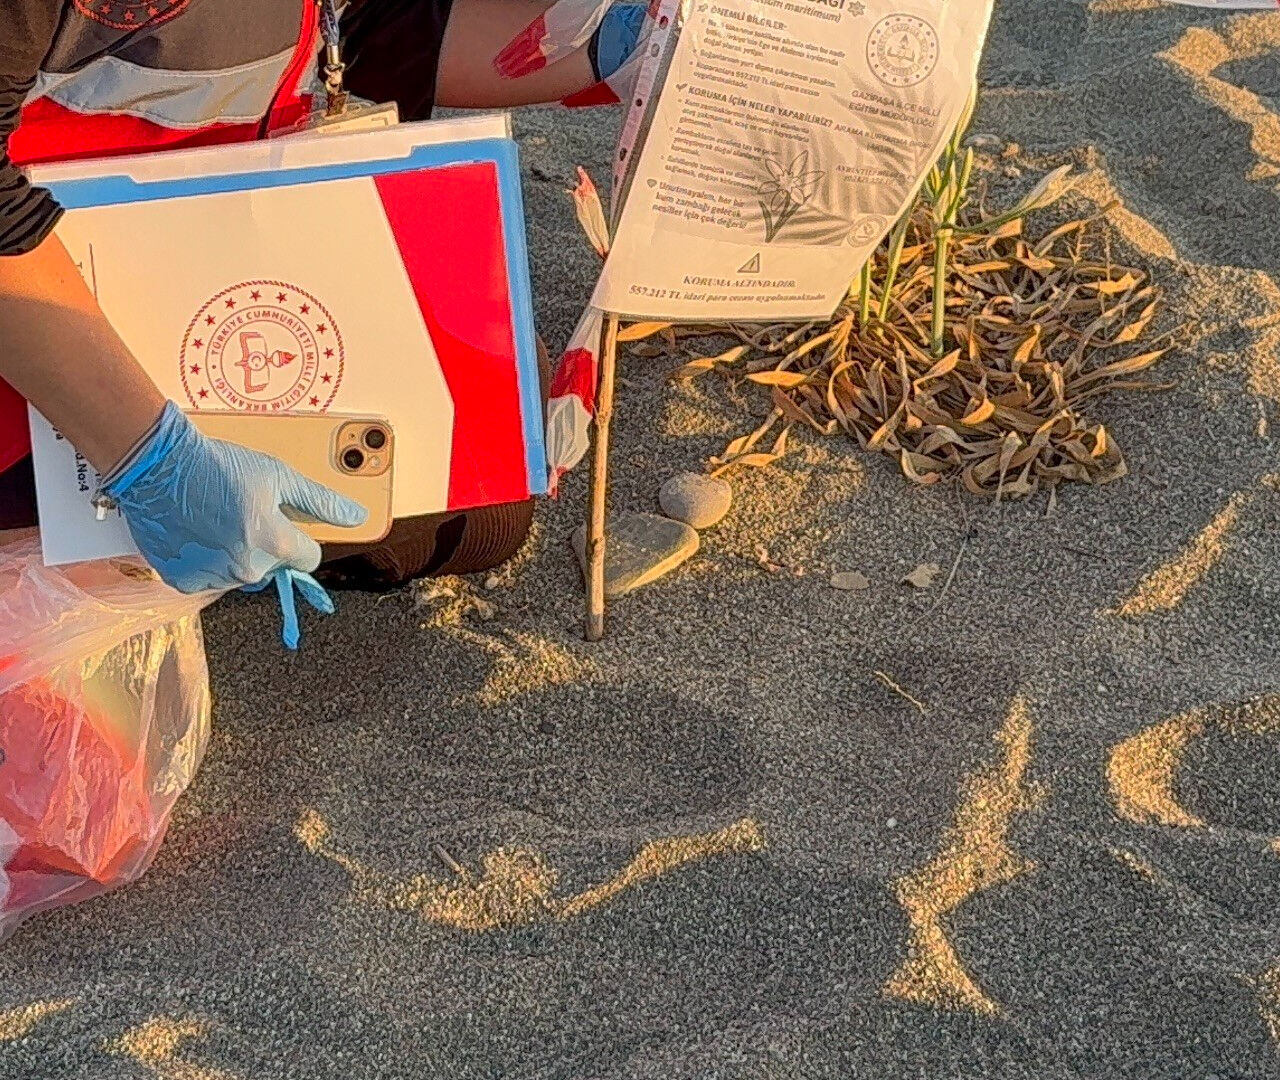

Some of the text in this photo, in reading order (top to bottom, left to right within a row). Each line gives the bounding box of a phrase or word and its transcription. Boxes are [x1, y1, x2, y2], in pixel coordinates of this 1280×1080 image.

[688, 85, 727, 102] KORUMA
[747, 100, 776, 114] NELER
[683, 274, 732, 288] KORUMA
[210, 315, 244, 356] TÜRKİYE
